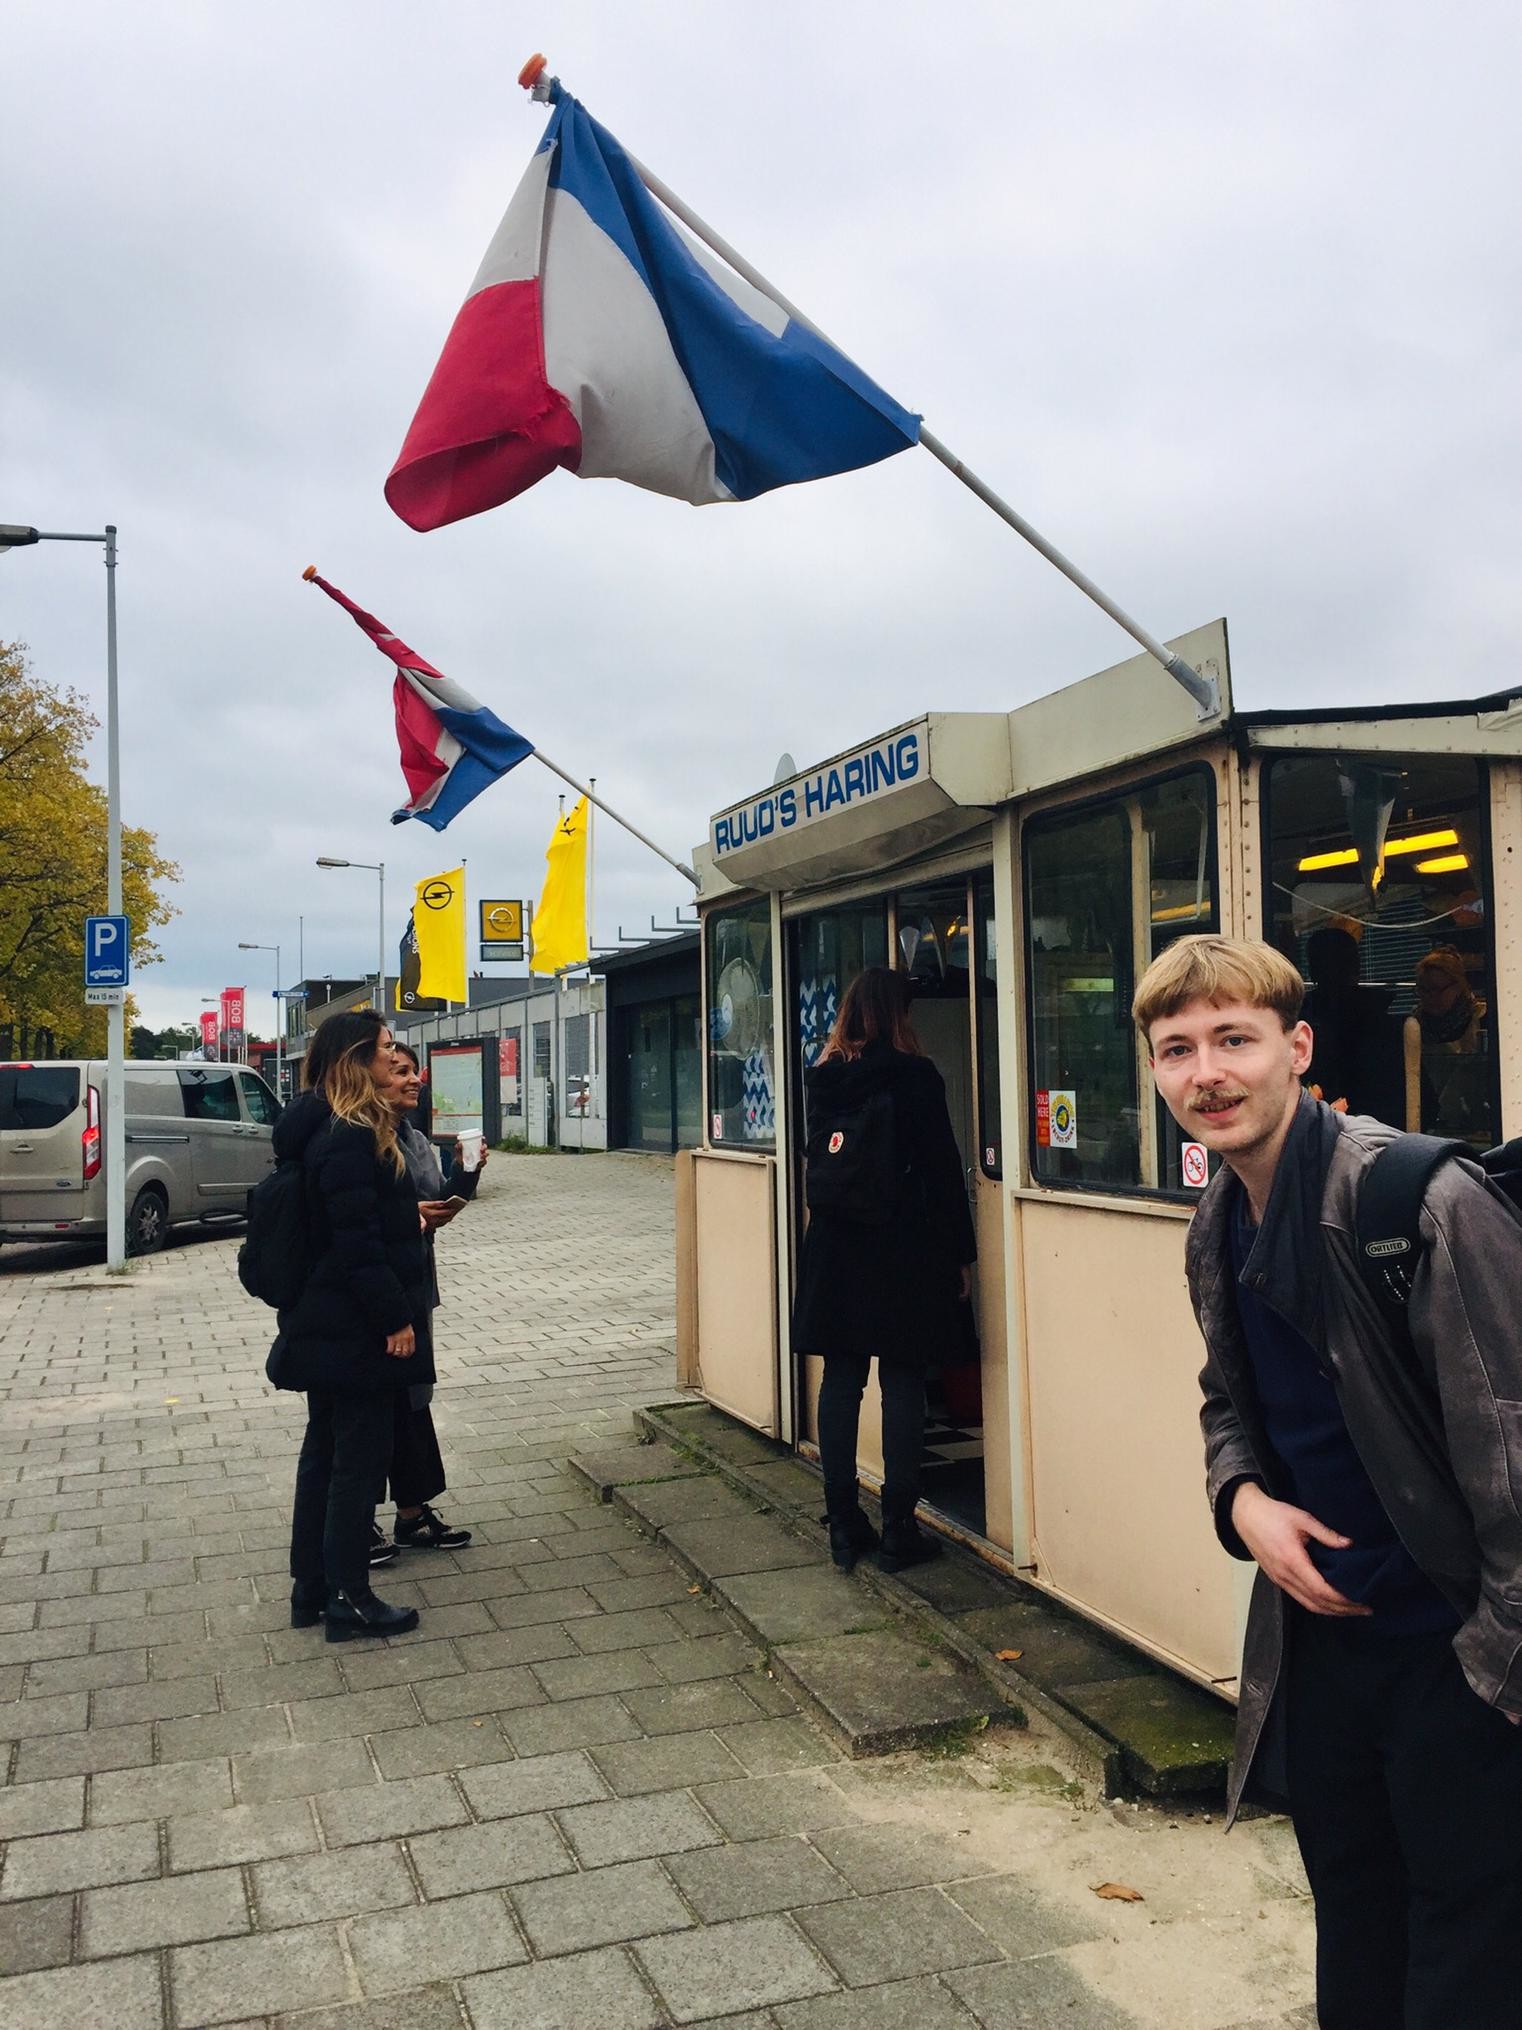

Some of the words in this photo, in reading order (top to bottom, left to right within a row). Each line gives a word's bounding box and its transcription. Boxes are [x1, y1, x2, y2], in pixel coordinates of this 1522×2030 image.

[715, 788, 797, 854] RUUD'S
[805, 734, 919, 817] HARING
[94, 922, 118, 957] P
[231, 999, 242, 1024] BOB
[1037, 1094, 1049, 1105] SOLD
[1037, 1106, 1049, 1118] HERE
